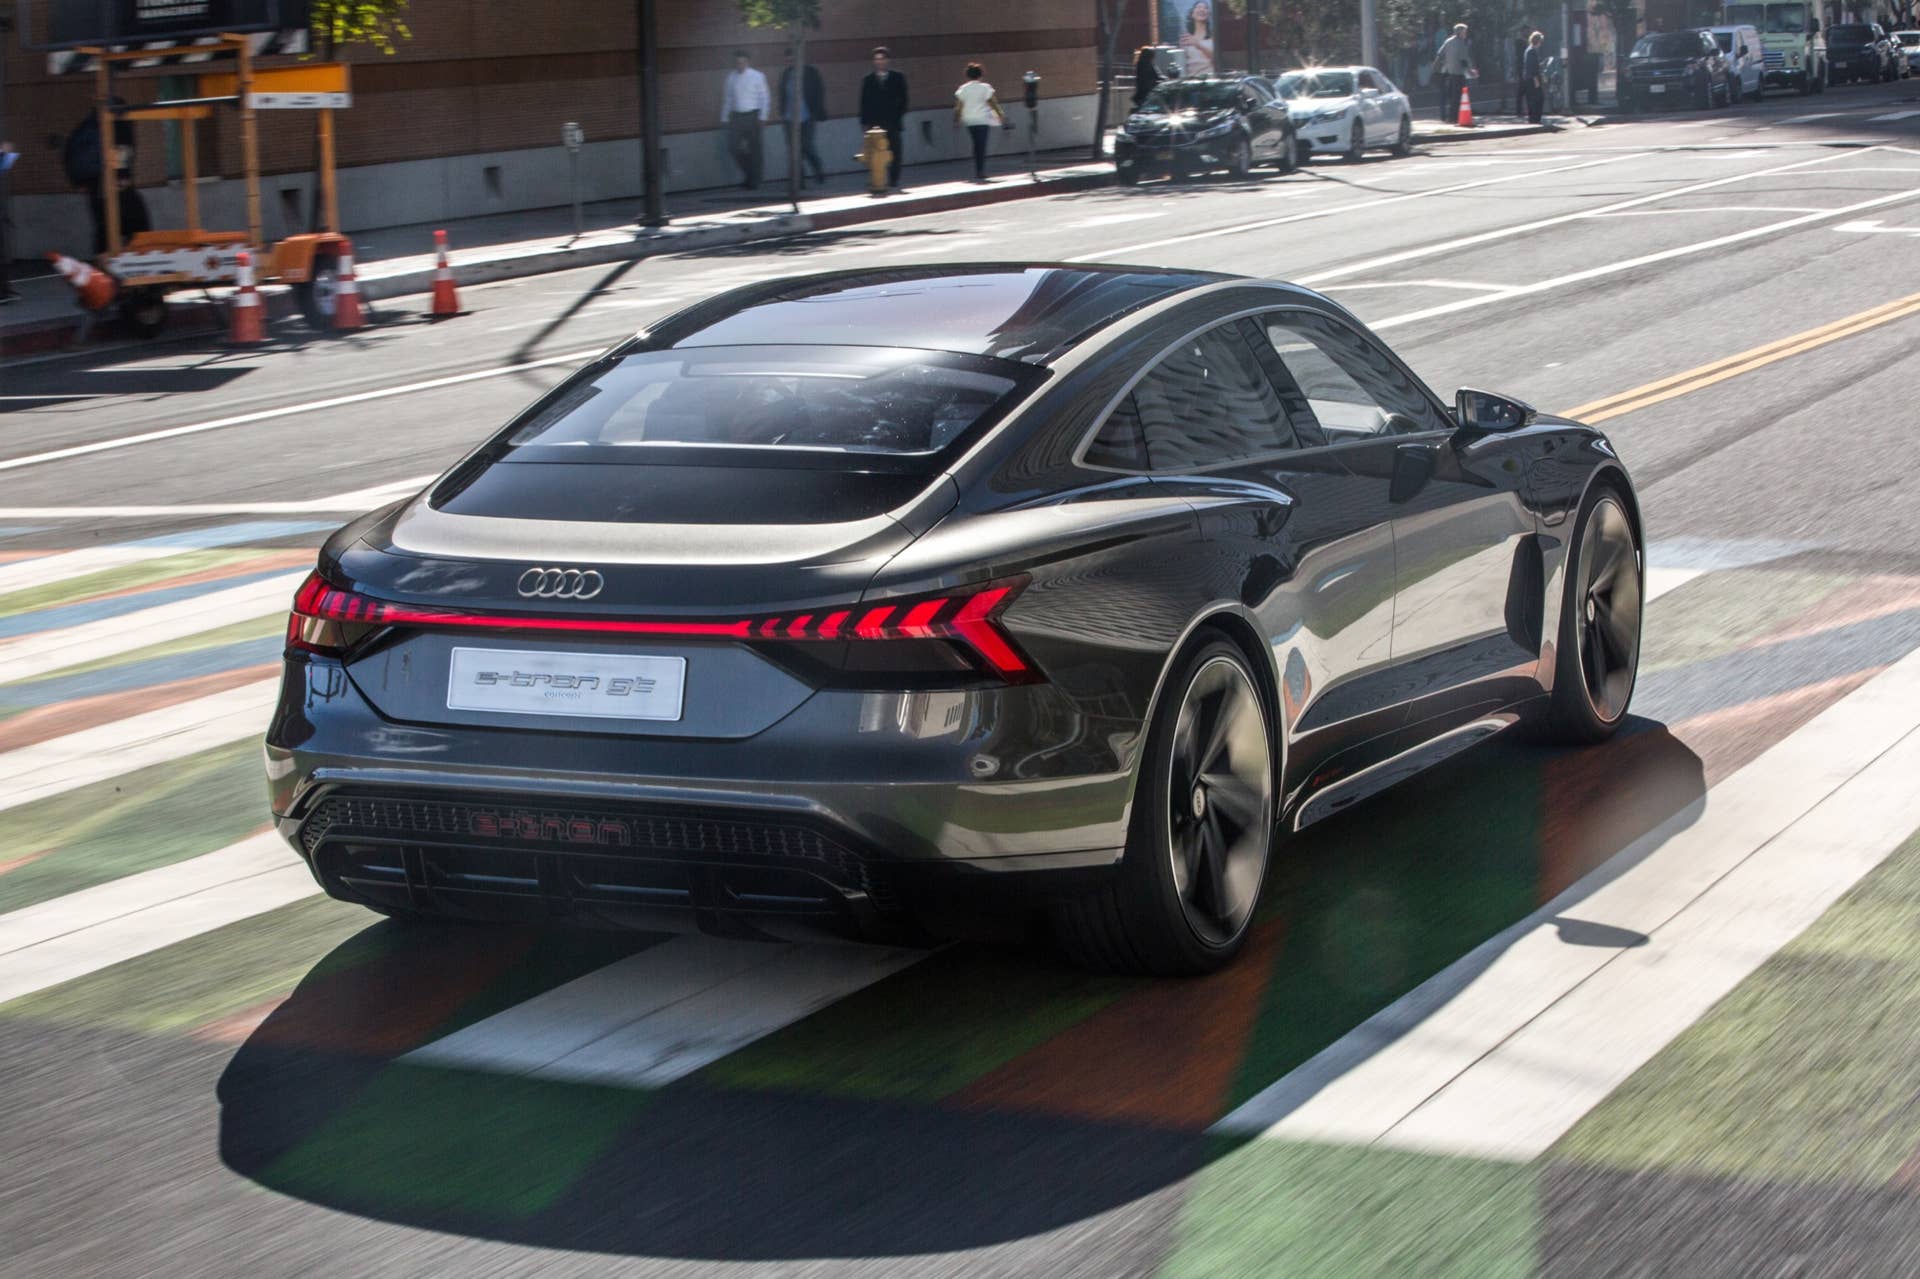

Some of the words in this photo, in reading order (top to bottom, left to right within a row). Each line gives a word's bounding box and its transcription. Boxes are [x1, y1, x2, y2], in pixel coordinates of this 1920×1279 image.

[474, 671, 600, 690] e-tron
[605, 676, 657, 697] gt
[469, 810, 631, 847] e-tron
